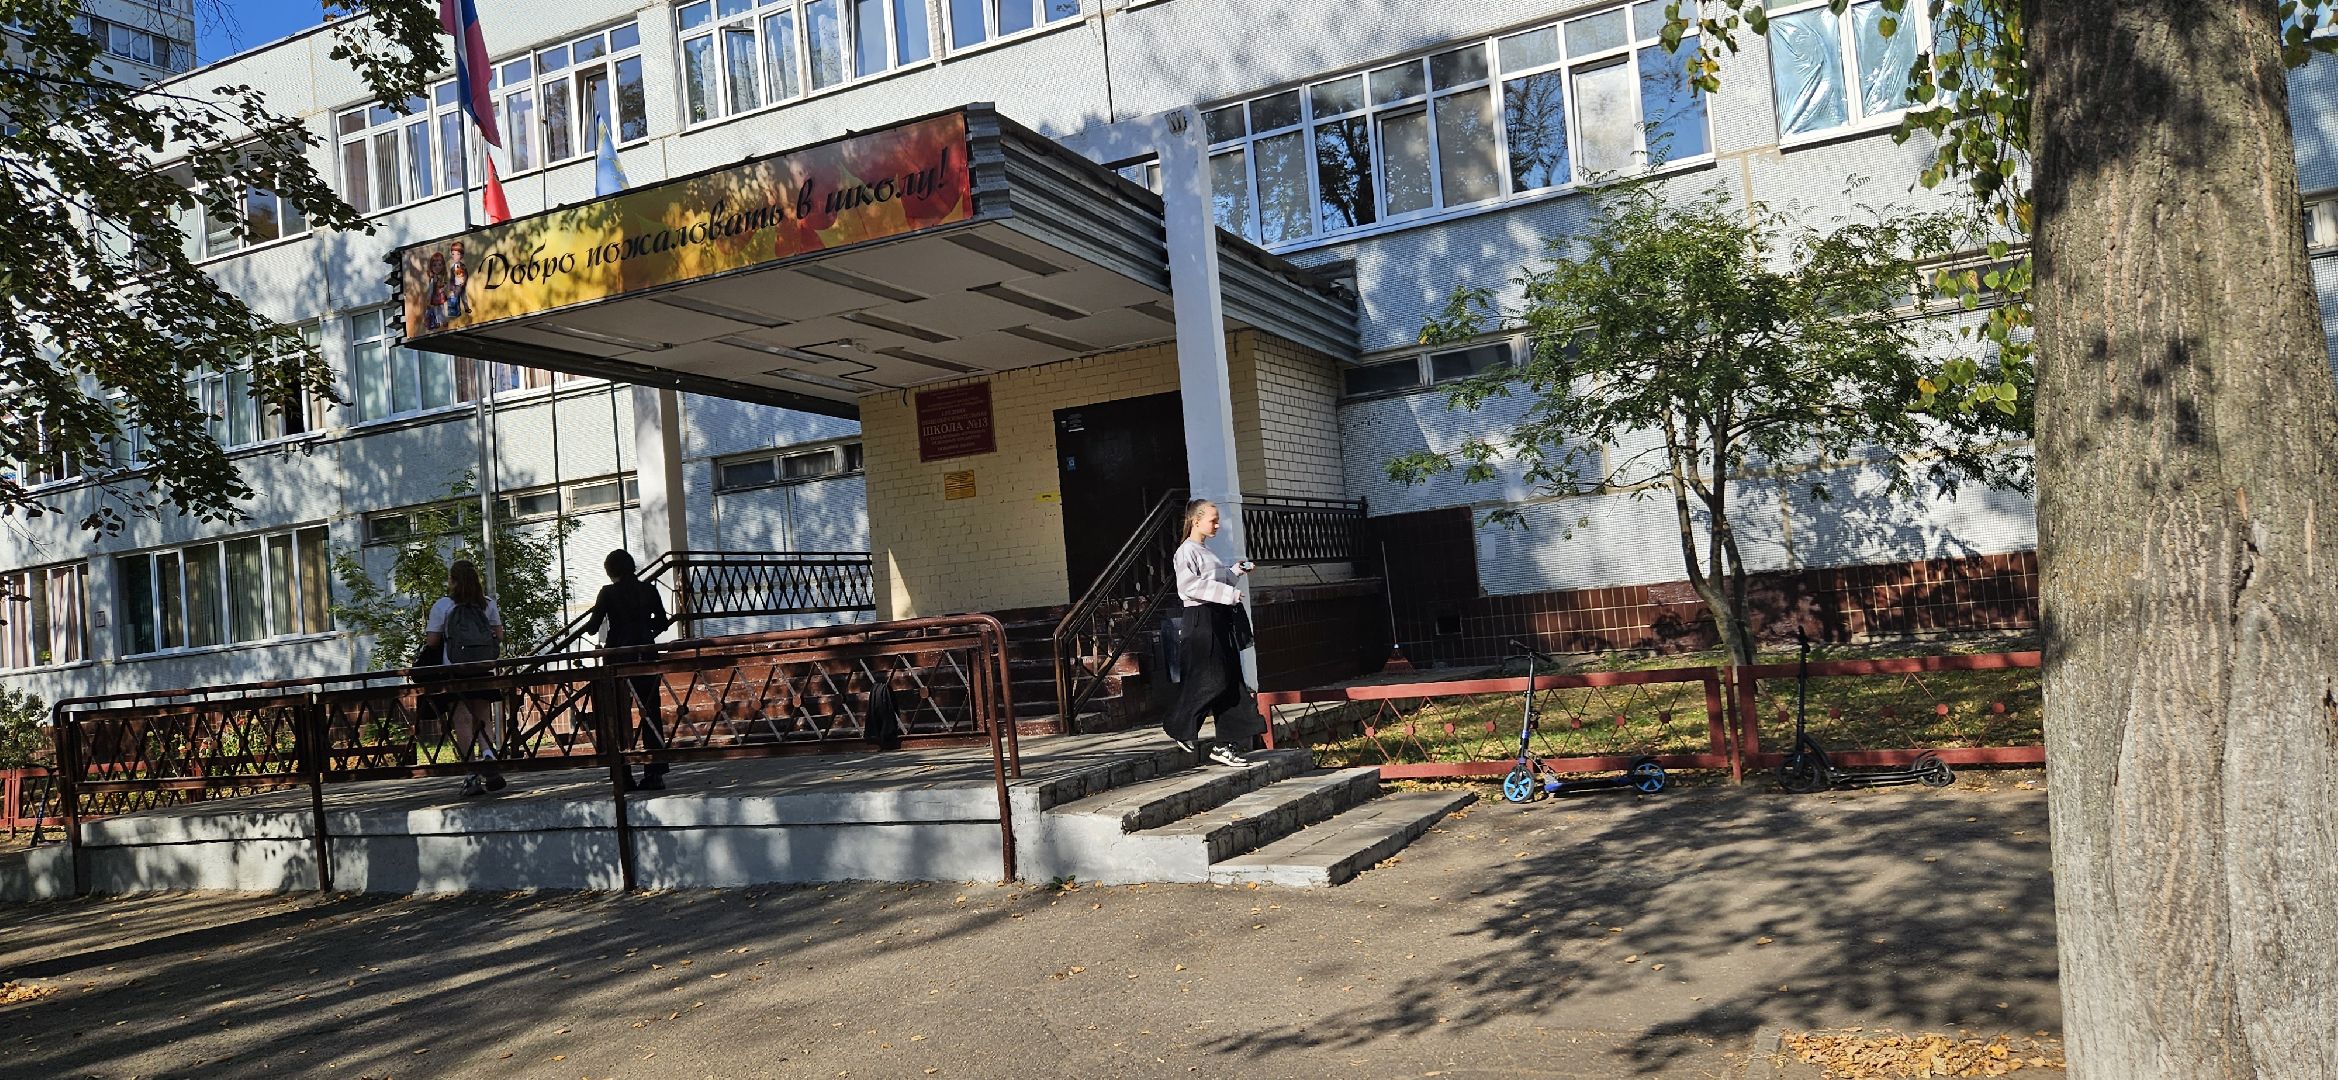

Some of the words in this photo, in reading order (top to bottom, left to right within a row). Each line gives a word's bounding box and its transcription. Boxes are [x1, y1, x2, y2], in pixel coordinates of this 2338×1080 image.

[478, 240, 575, 290] Добро
[586, 200, 784, 268] пожаловать
[796, 177, 815, 220] в
[825, 146, 949, 211] школу!
[923, 422, 963, 436] ШКОЛА
[966, 417, 988, 430] №13
